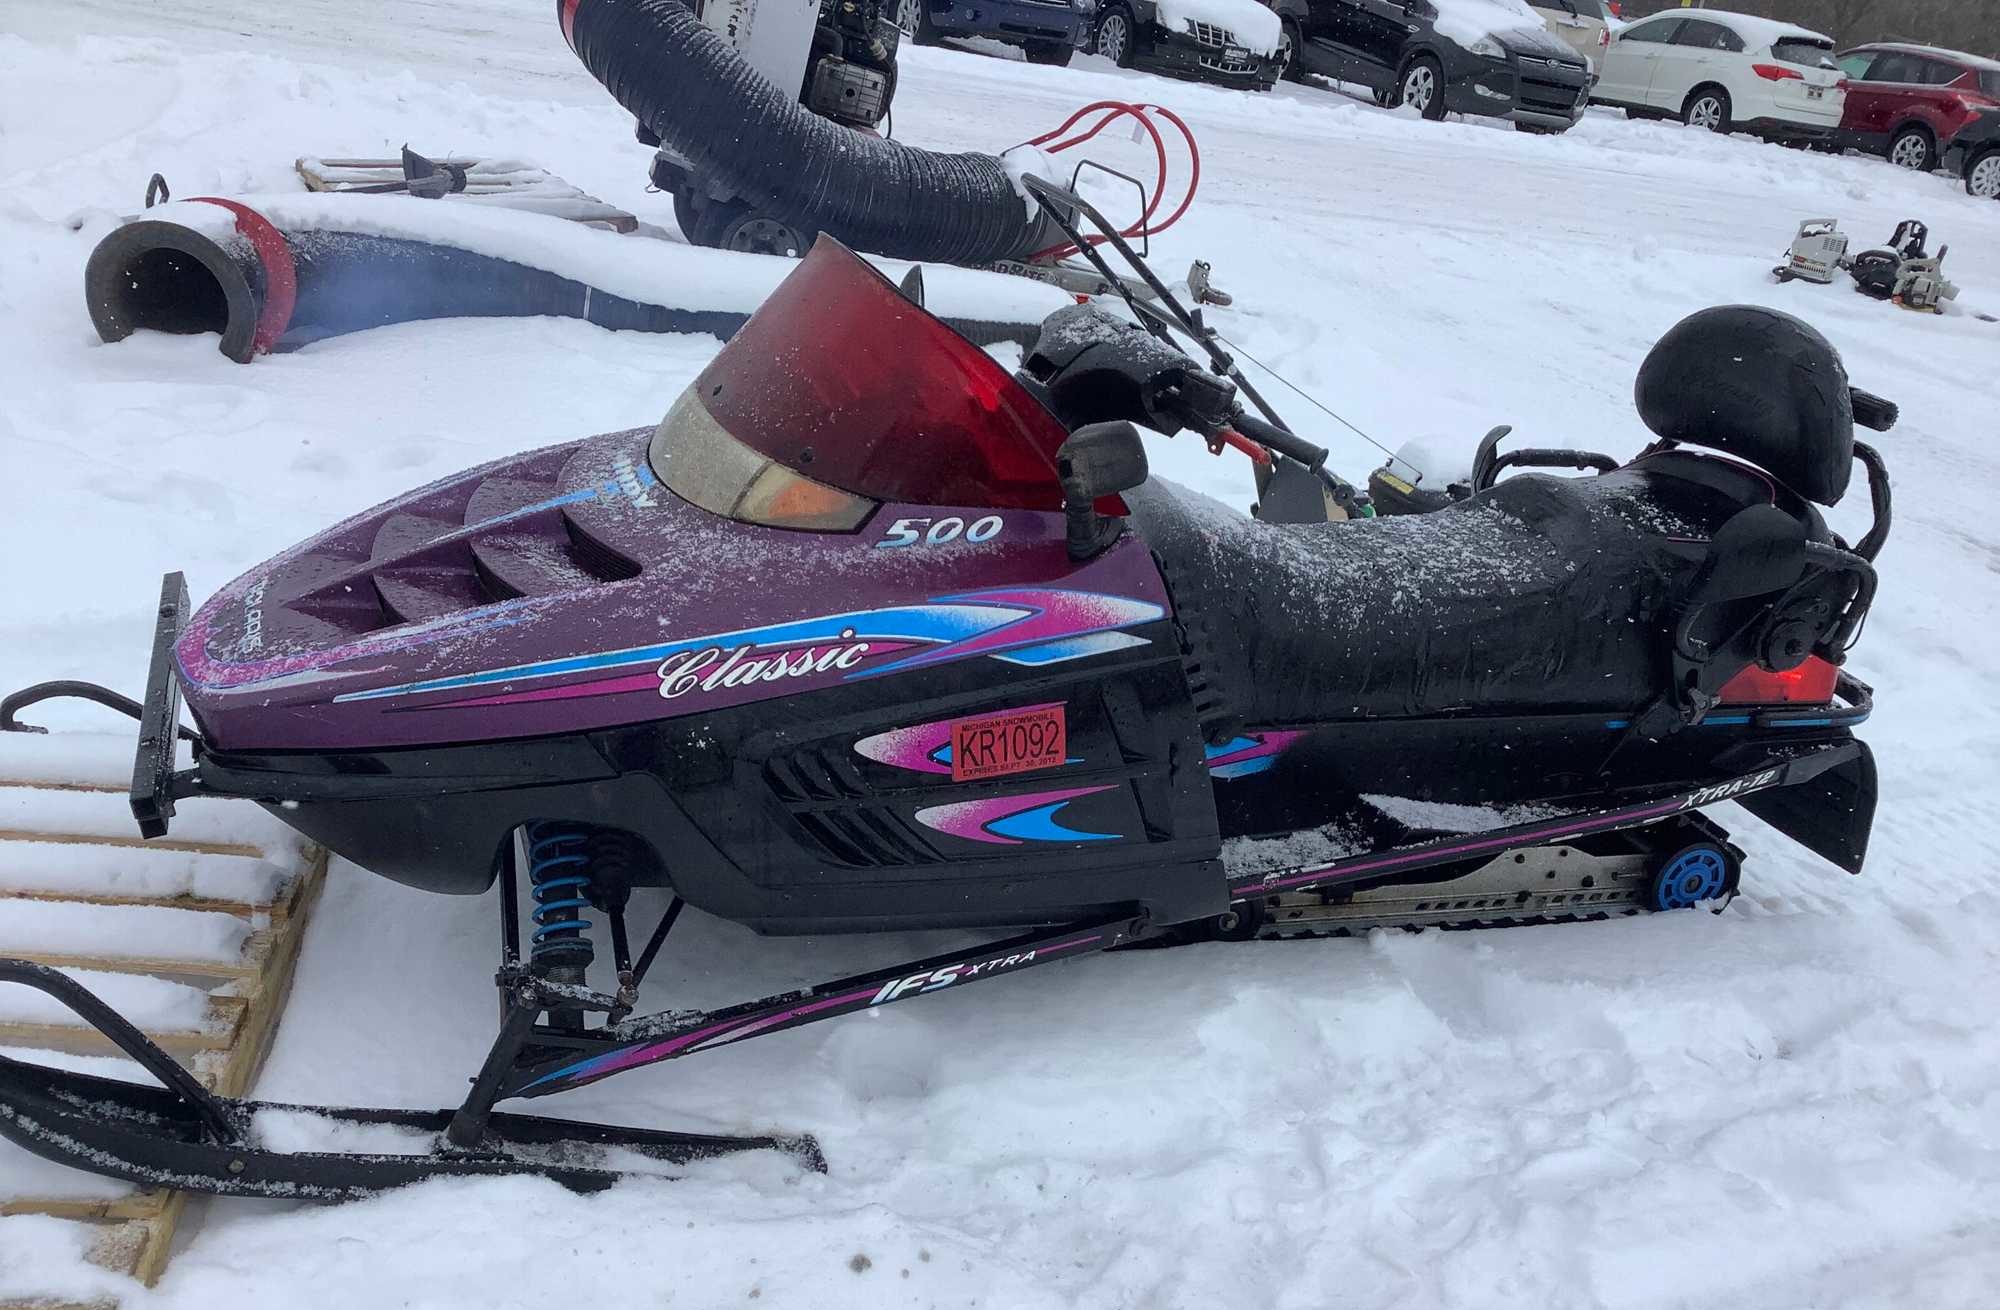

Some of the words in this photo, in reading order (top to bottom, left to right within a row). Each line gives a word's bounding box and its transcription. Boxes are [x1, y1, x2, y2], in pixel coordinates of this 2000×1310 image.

[874, 515, 1004, 548] 500
[656, 629, 869, 699] Classic
[961, 720, 1001, 732] MICHIGAN
[1003, 712, 1055, 727] SNOWMOBILE
[959, 720, 1060, 769] KR1092
[1678, 770, 1776, 810] XTRA-12
[869, 963, 965, 1005] IFS
[965, 950, 1037, 976] XTRA
